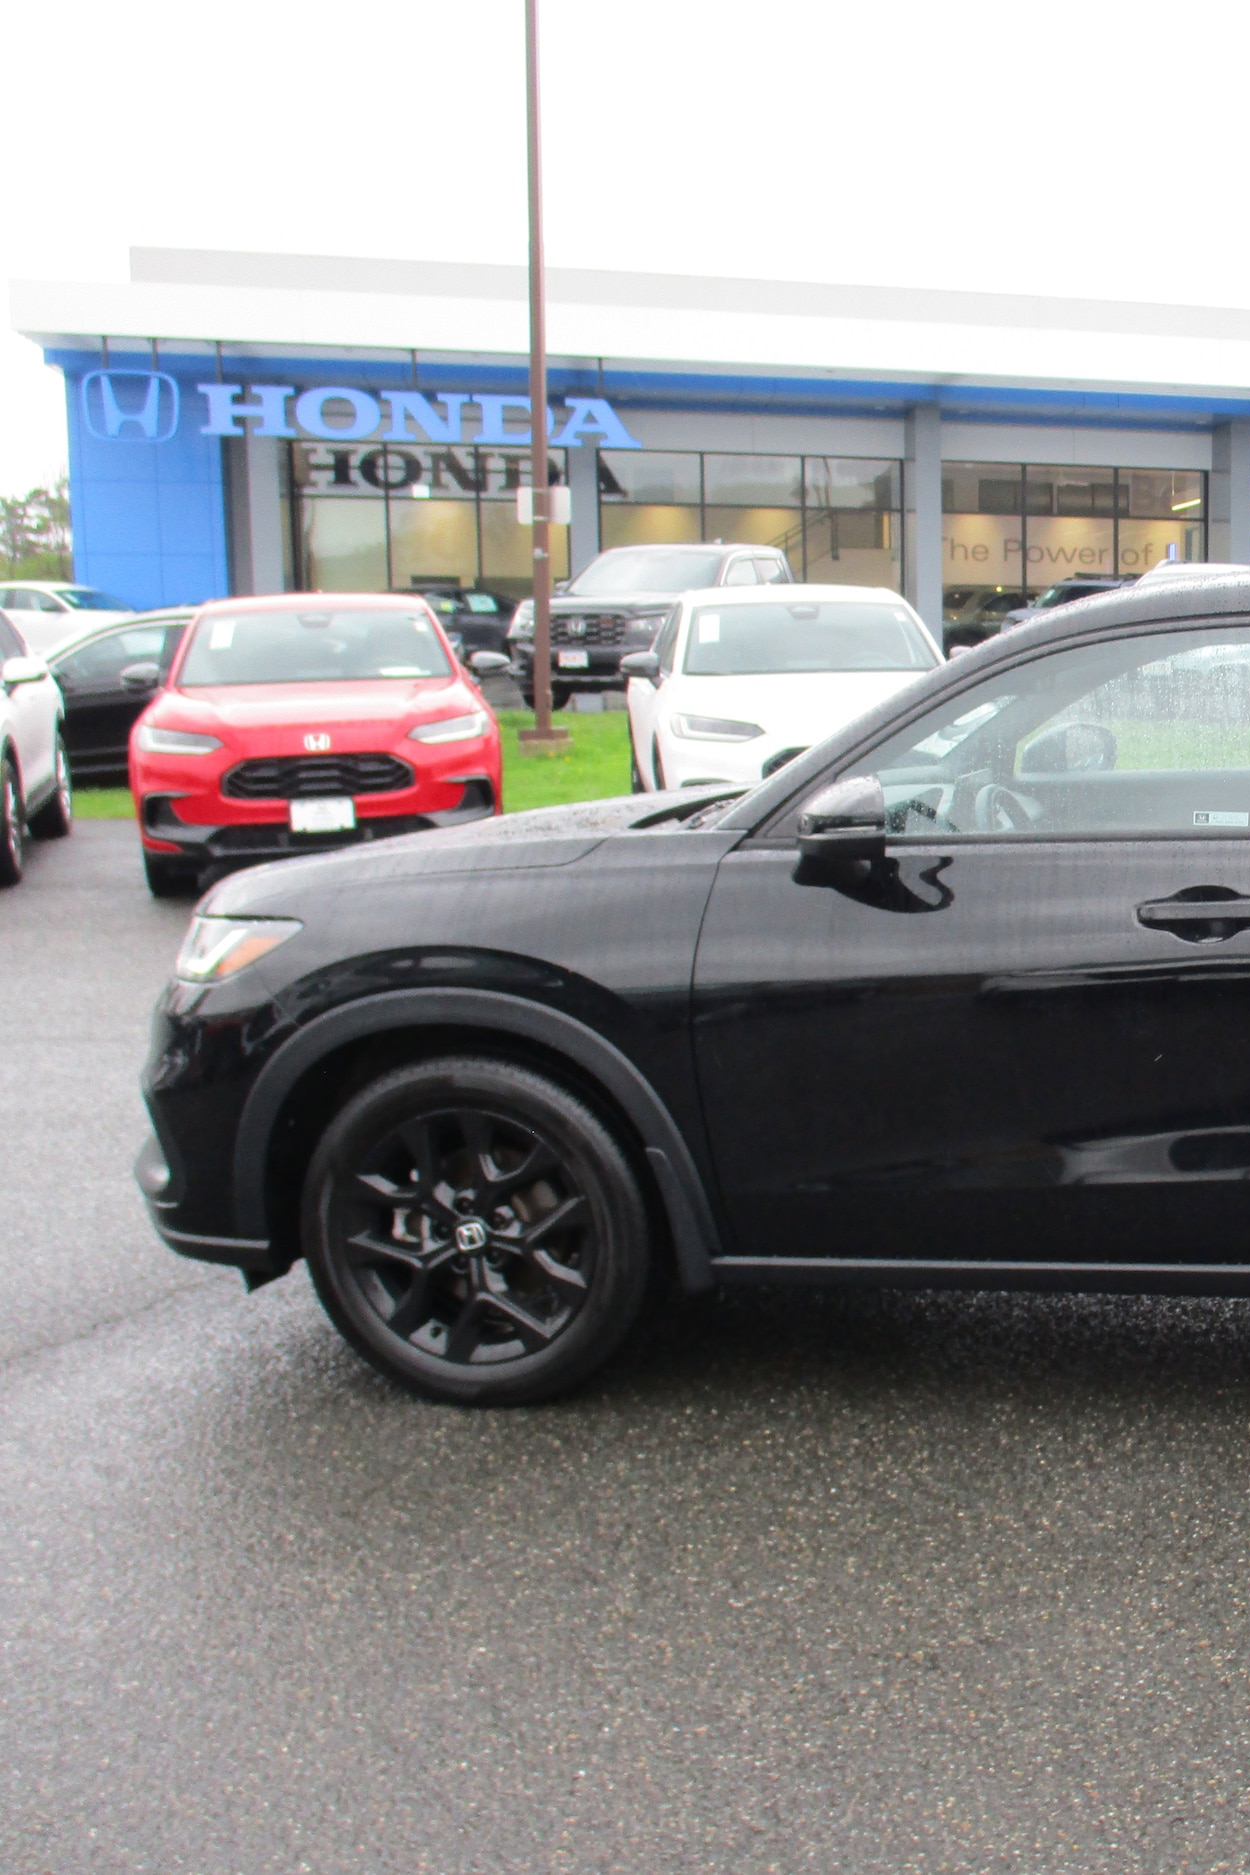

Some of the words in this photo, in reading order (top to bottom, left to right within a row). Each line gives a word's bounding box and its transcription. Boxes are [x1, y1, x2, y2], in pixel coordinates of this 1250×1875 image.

[197, 383, 642, 449] HONDA
[941, 536, 990, 562] he
[1004, 538, 1113, 565] Power
[1121, 543, 1153, 566] of
